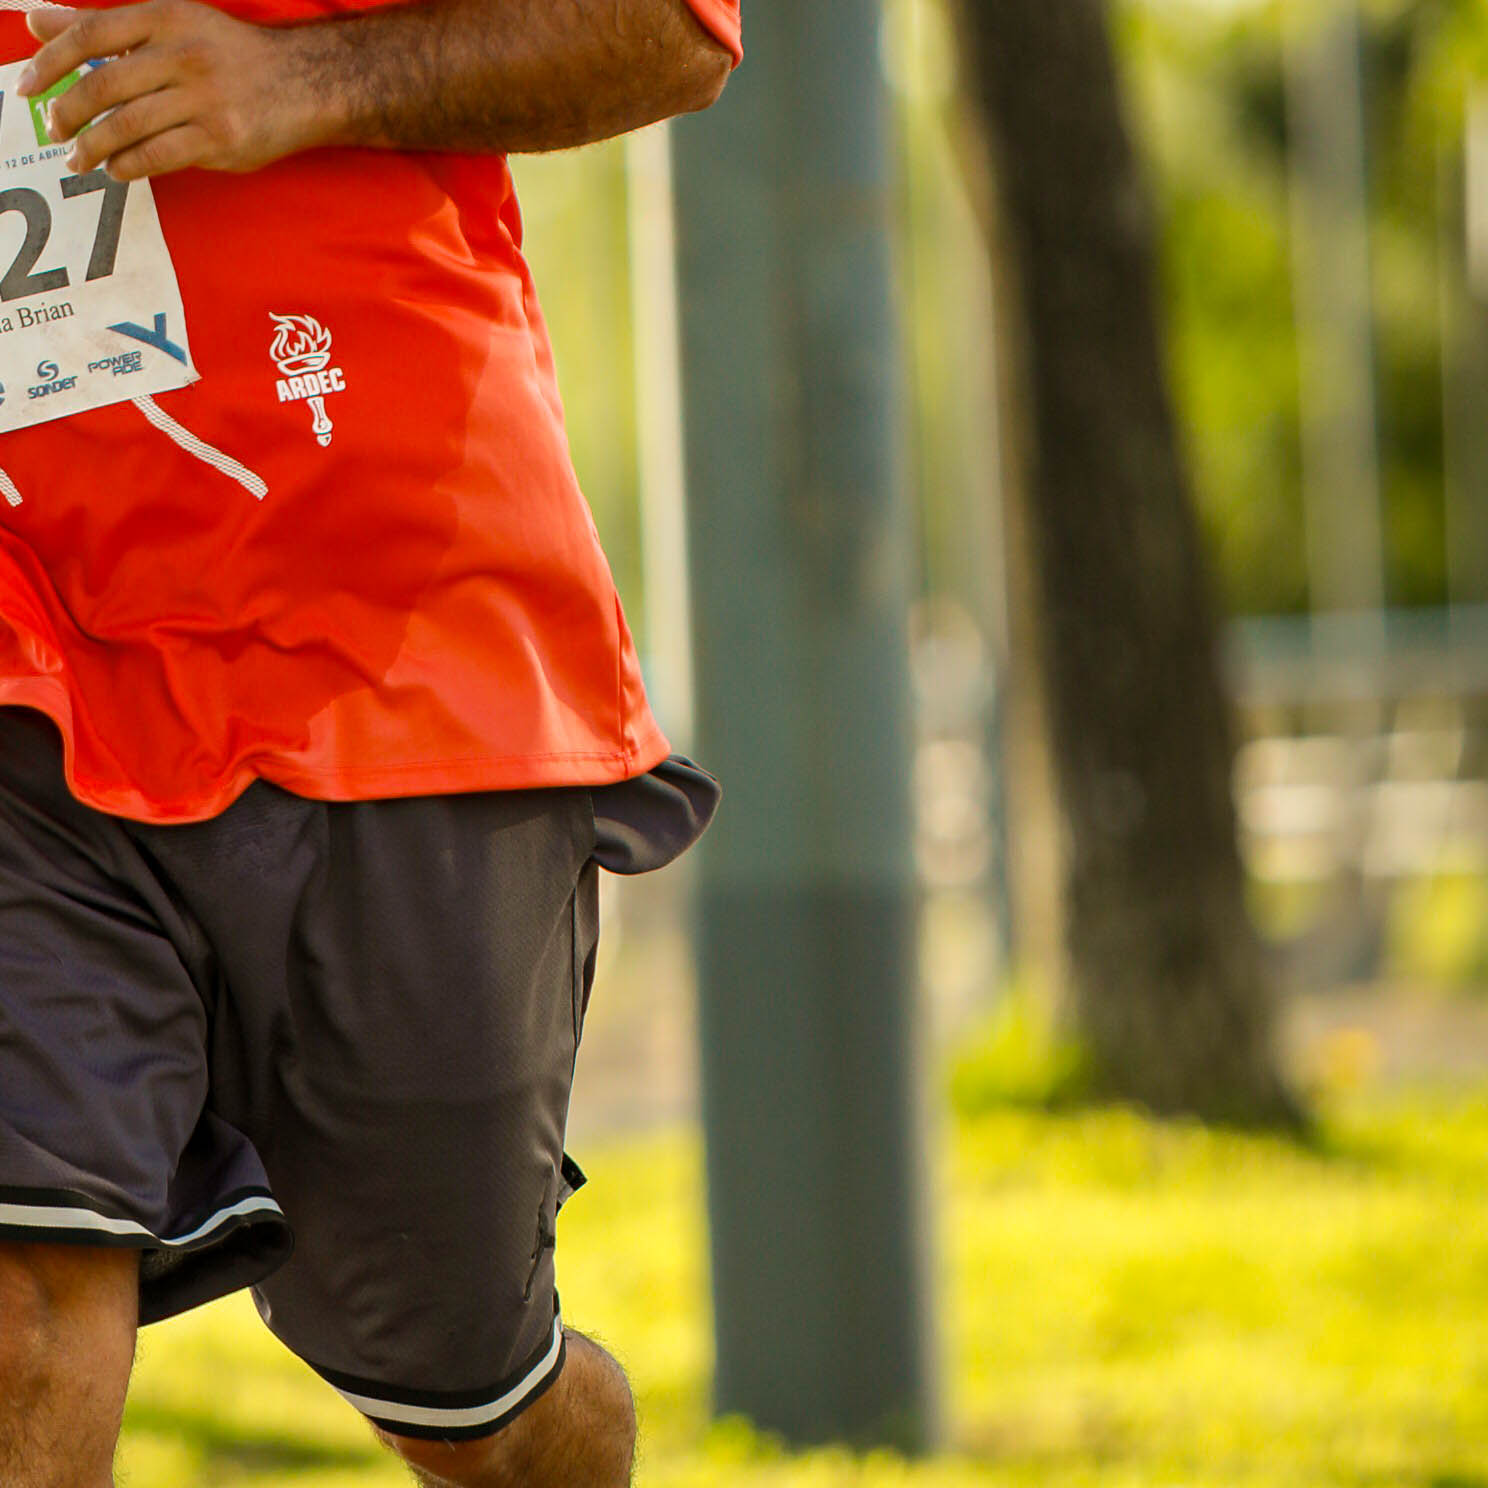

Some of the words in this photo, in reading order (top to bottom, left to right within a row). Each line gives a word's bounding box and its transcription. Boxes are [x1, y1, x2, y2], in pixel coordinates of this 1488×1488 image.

[5, 158, 17, 169] 12
[21, 154, 35, 165] DE
[39, 147, 68, 161] ABRIL
[16, 301, 74, 328] Brian
[88, 350, 142, 373] POWER
[276, 367, 346, 402] ARDEC
